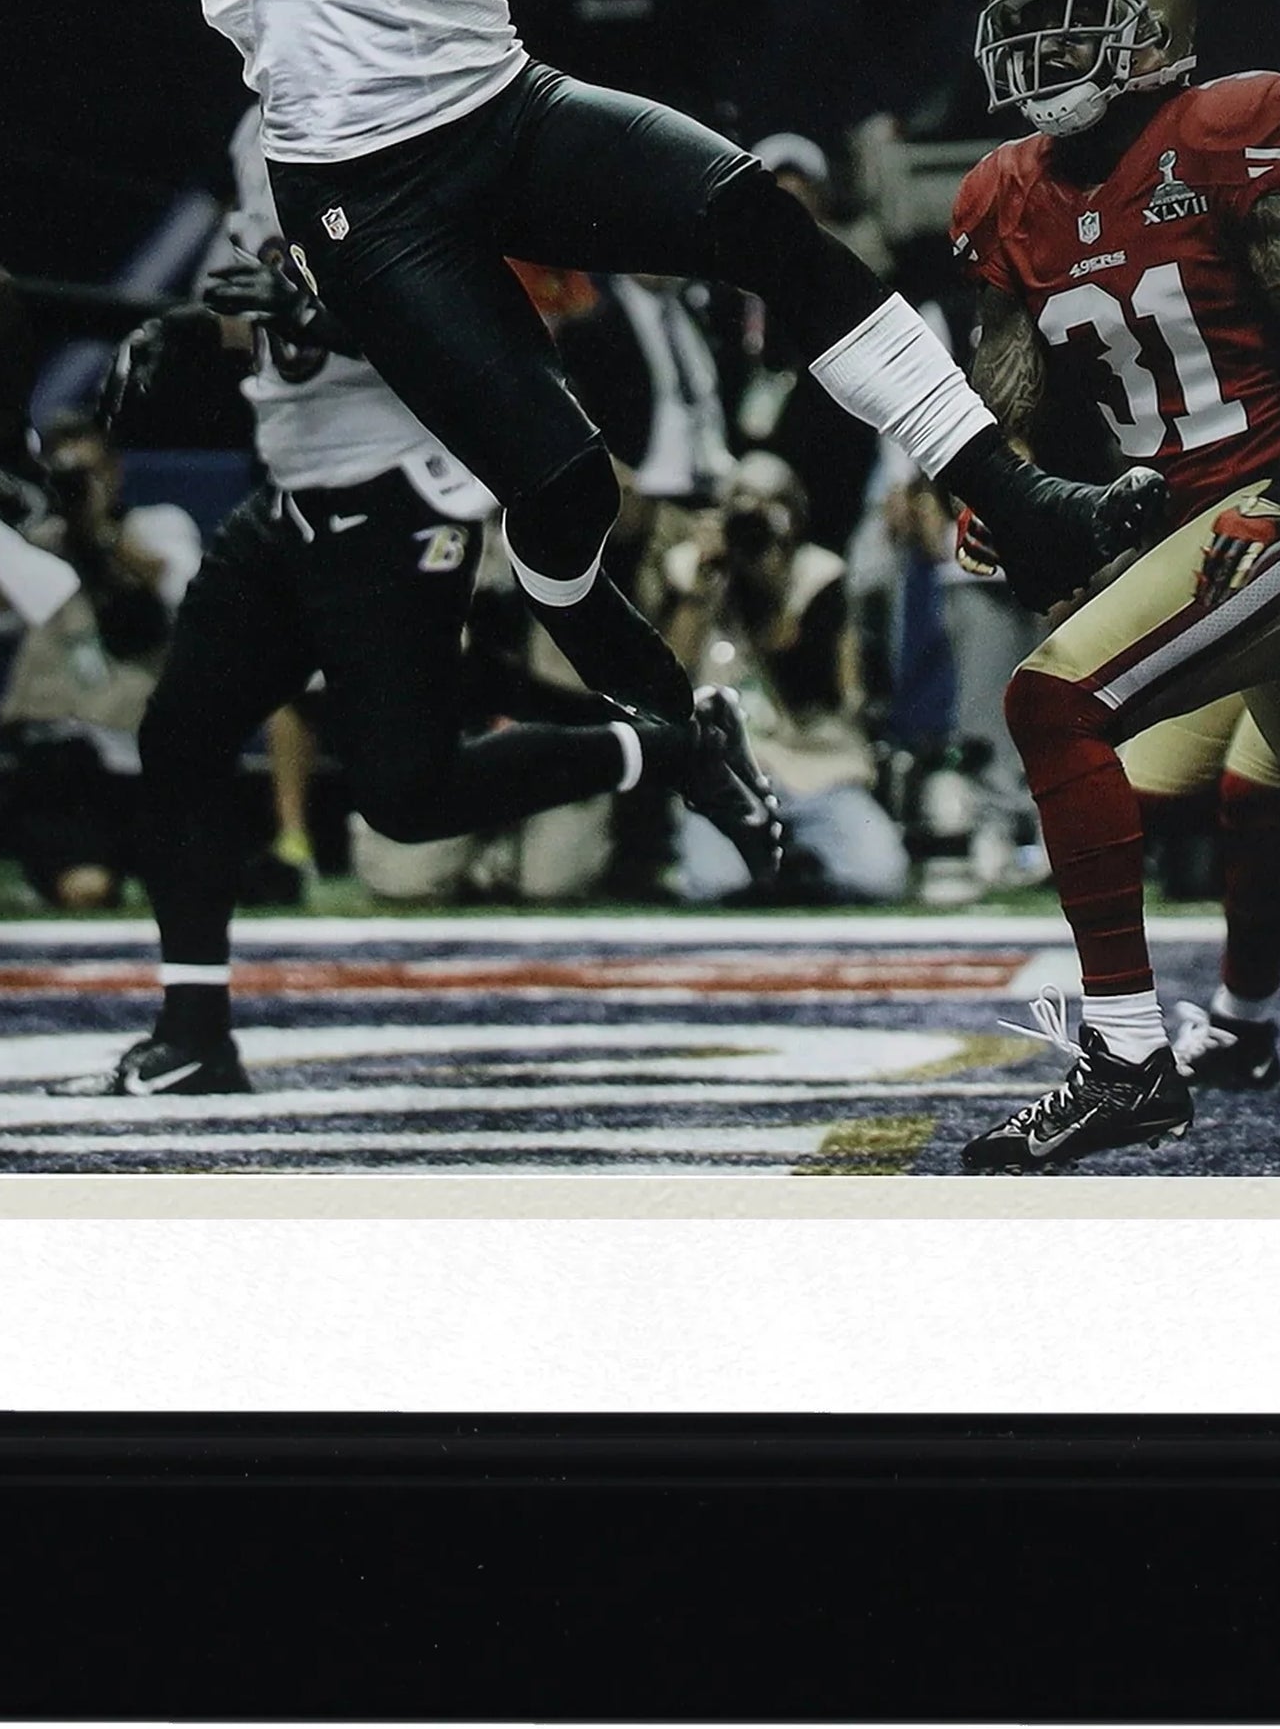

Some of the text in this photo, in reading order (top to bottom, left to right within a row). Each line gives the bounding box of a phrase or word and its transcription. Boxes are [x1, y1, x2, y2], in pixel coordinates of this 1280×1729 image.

[1142, 195, 1209, 226] XLVII
[1069, 250, 1127, 279] 49ERS
[1038, 262, 1249, 458] 31
